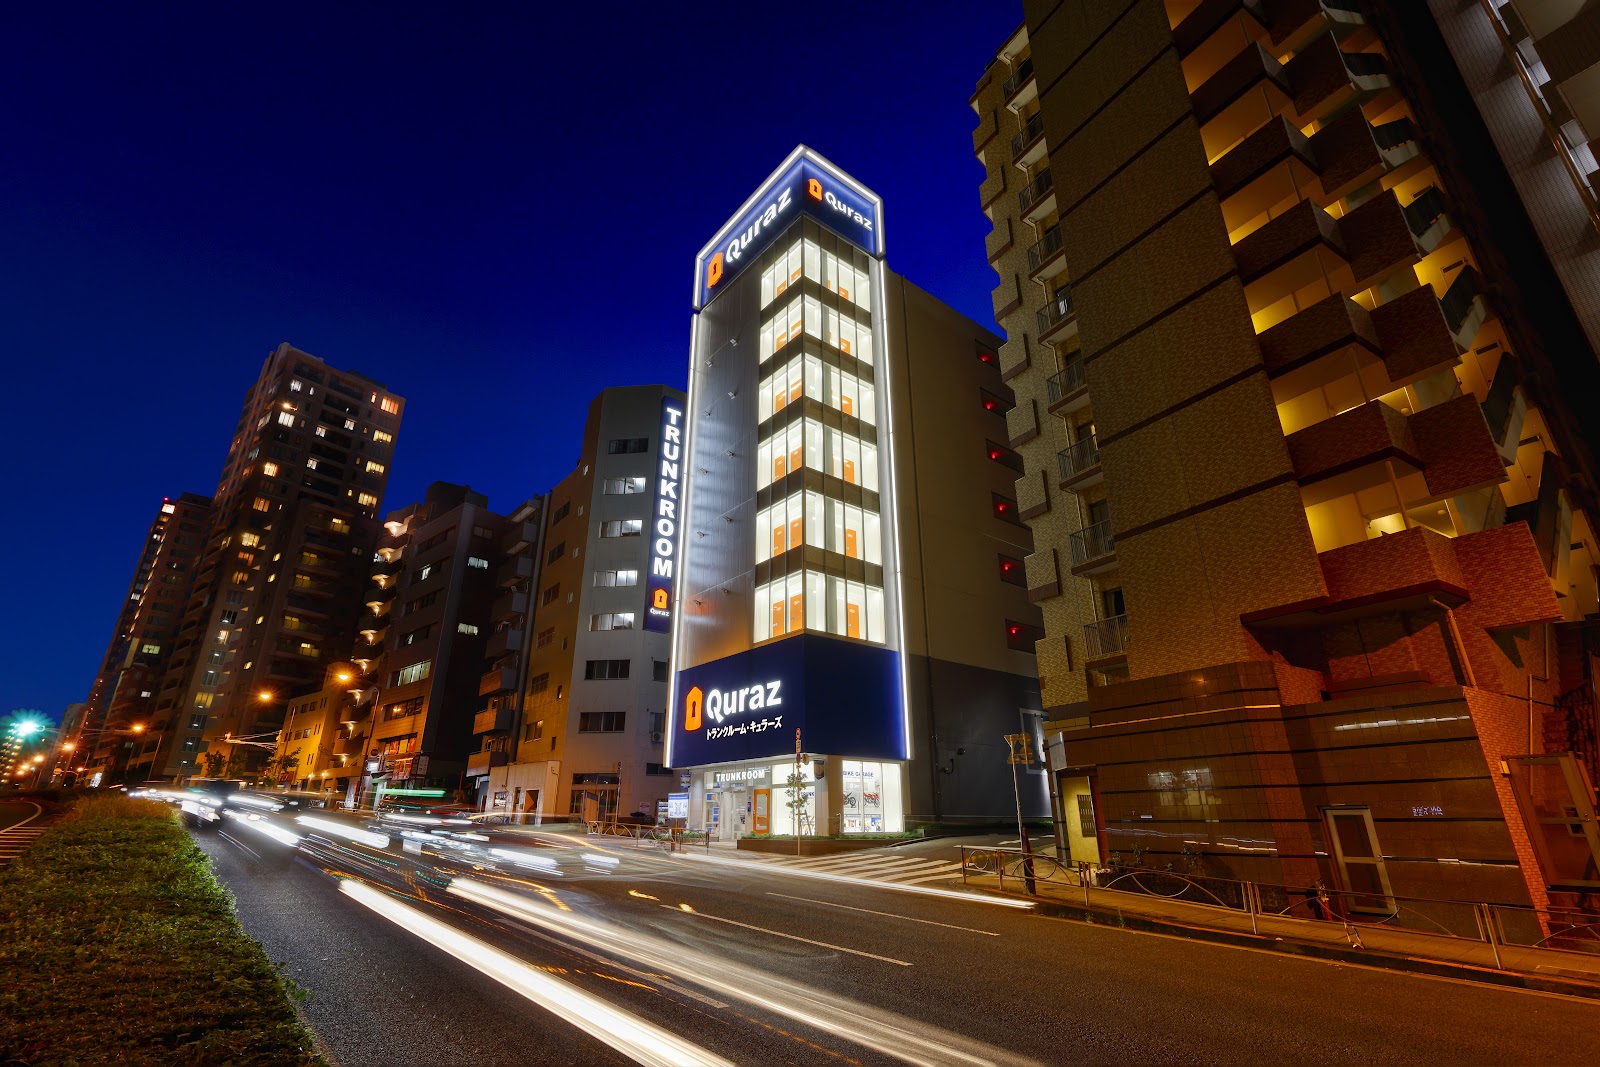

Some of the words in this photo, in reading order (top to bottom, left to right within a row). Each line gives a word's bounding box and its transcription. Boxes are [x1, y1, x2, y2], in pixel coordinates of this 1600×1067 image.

[725, 187, 792, 263] Quraz
[825, 191, 873, 231] Quraz
[653, 407, 682, 578] TRUNKROOM
[649, 607, 670, 617] Quraz
[706, 680, 782, 723] Quraz
[706, 715, 783, 741] トランクルーム・キュラーズ
[716, 769, 765, 783] TRUNKROOM
